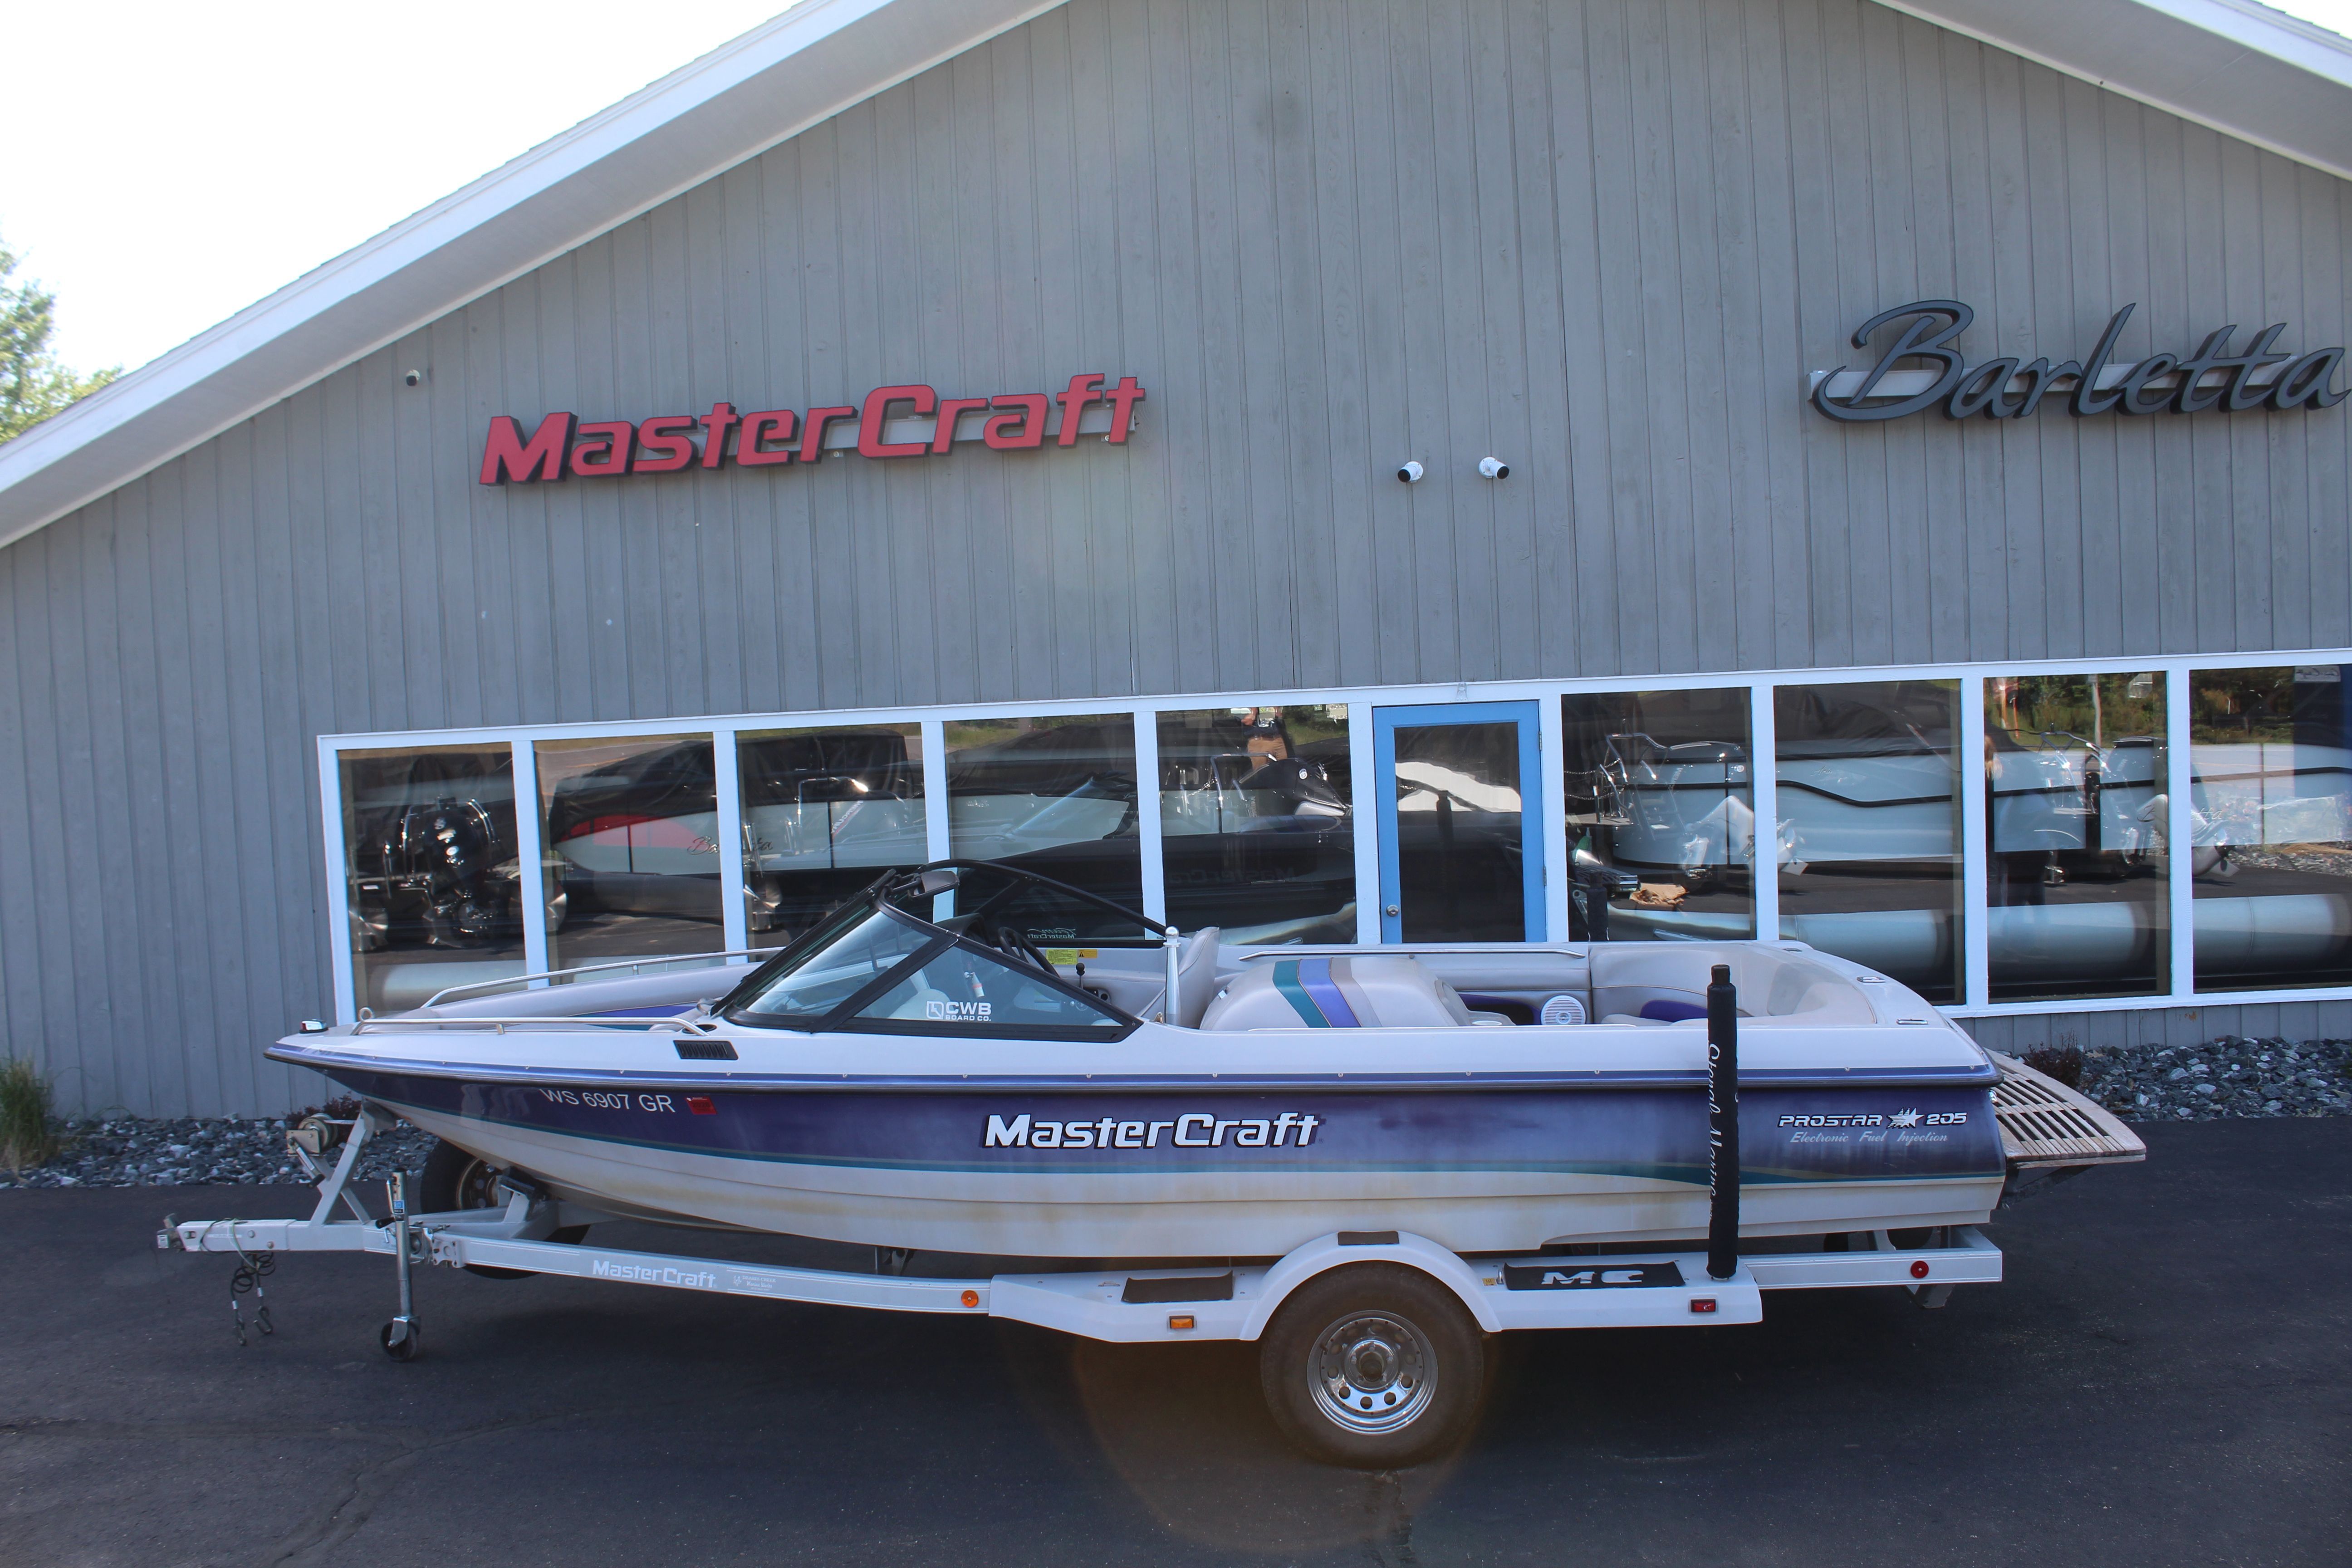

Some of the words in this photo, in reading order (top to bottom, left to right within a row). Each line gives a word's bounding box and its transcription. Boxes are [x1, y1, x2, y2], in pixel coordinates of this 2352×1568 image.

[1814, 299, 2351, 422] Barletta
[479, 373, 1145, 485] MasterCraft
[946, 1001, 991, 1015] CWB
[539, 1088, 579, 1105] WS
[582, 1092, 630, 1110] 6907
[638, 1094, 676, 1113] GR
[981, 1112, 1320, 1149] MasterCraft
[1778, 1113, 1883, 1127] PROSTAR
[1925, 1112, 1968, 1126] 205
[1789, 1131, 1849, 1143] Electronic
[1858, 1131, 1888, 1142] Fuel
[1896, 1131, 1948, 1147] Injection
[592, 1259, 716, 1288] MasterCraft
[1541, 1270, 1644, 1285] MC
